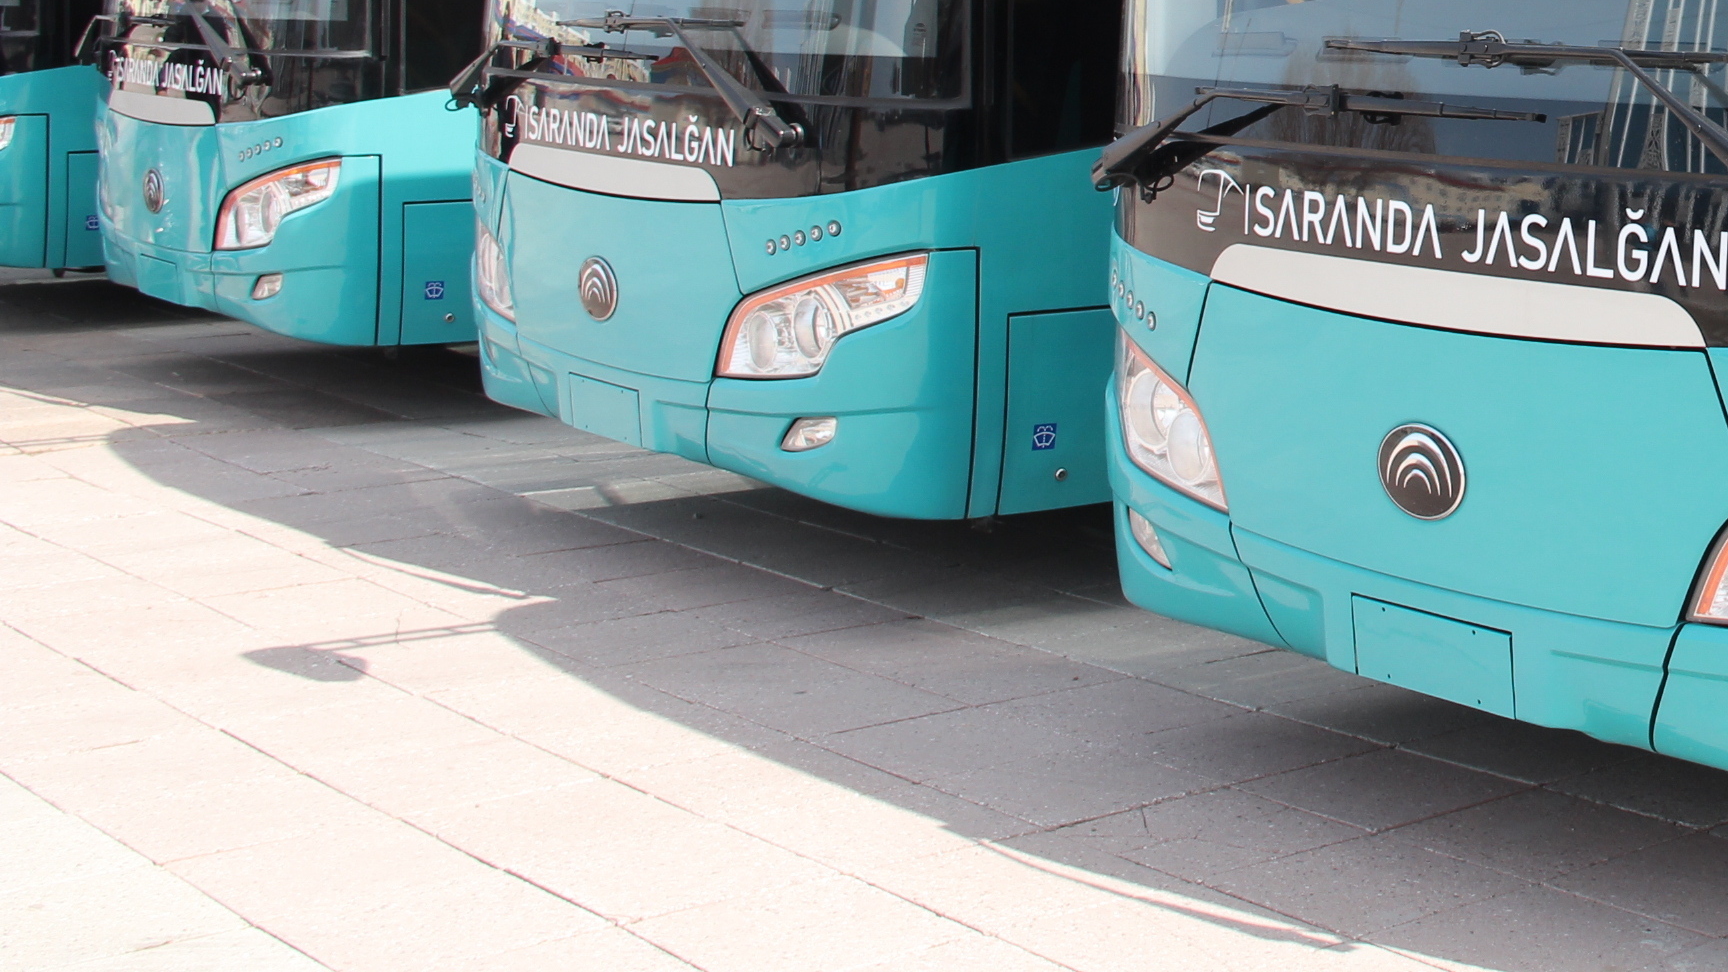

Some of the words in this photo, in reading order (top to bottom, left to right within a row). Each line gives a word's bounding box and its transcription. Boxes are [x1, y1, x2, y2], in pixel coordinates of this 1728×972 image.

[529, 106, 611, 151] SARANDA
[617, 114, 736, 168] JASALĞAN
[1253, 184, 1443, 259] SARANDA
